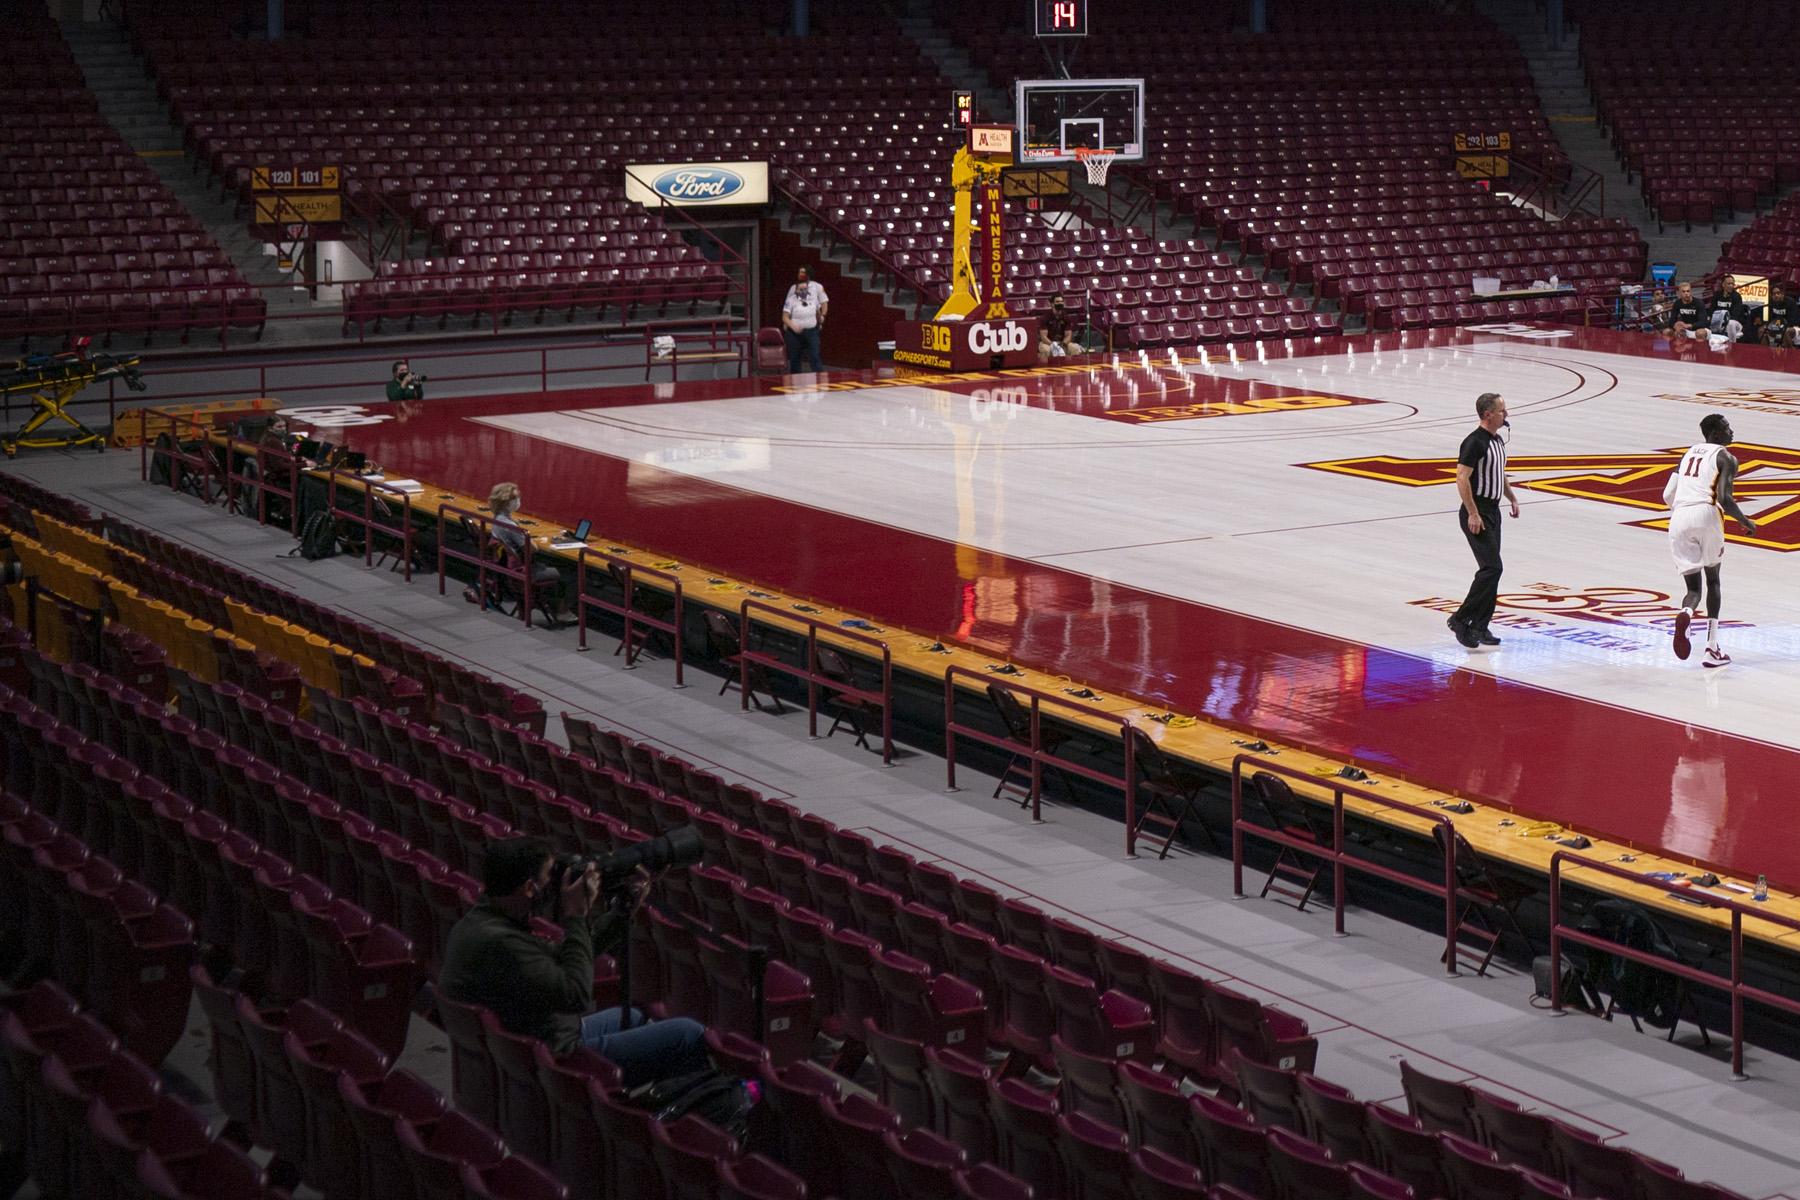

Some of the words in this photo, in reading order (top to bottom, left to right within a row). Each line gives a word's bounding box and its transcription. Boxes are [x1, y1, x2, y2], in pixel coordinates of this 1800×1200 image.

[1053, 2, 1075, 28] 14
[271, 170, 292, 184] 120
[300, 171, 320, 183] 101
[669, 171, 726, 197] Ford
[987, 188, 1002, 298] MINNESOTA
[968, 321, 1028, 355] Cub
[893, 350, 952, 369] GOPHERSPORTS.com
[1684, 457, 1703, 477] 11
